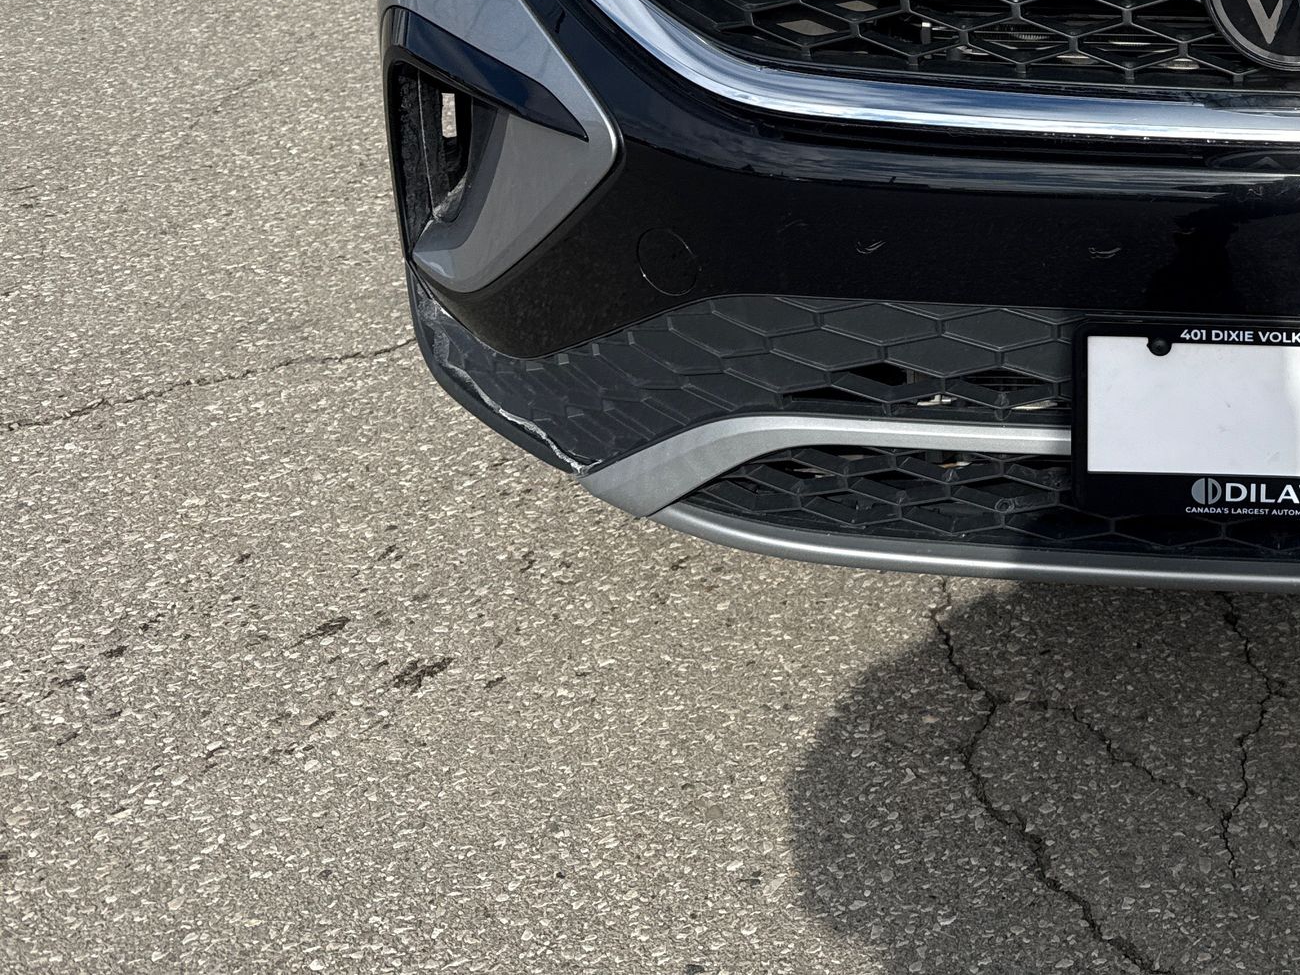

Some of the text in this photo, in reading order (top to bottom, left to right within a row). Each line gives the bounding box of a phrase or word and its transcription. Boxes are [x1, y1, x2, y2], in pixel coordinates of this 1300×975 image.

[1180, 329, 1207, 341] 401
[1211, 330, 1254, 342] DIXIE
[1185, 506, 1229, 514] CANADA'S
[1231, 507, 1269, 515] LARGEST
